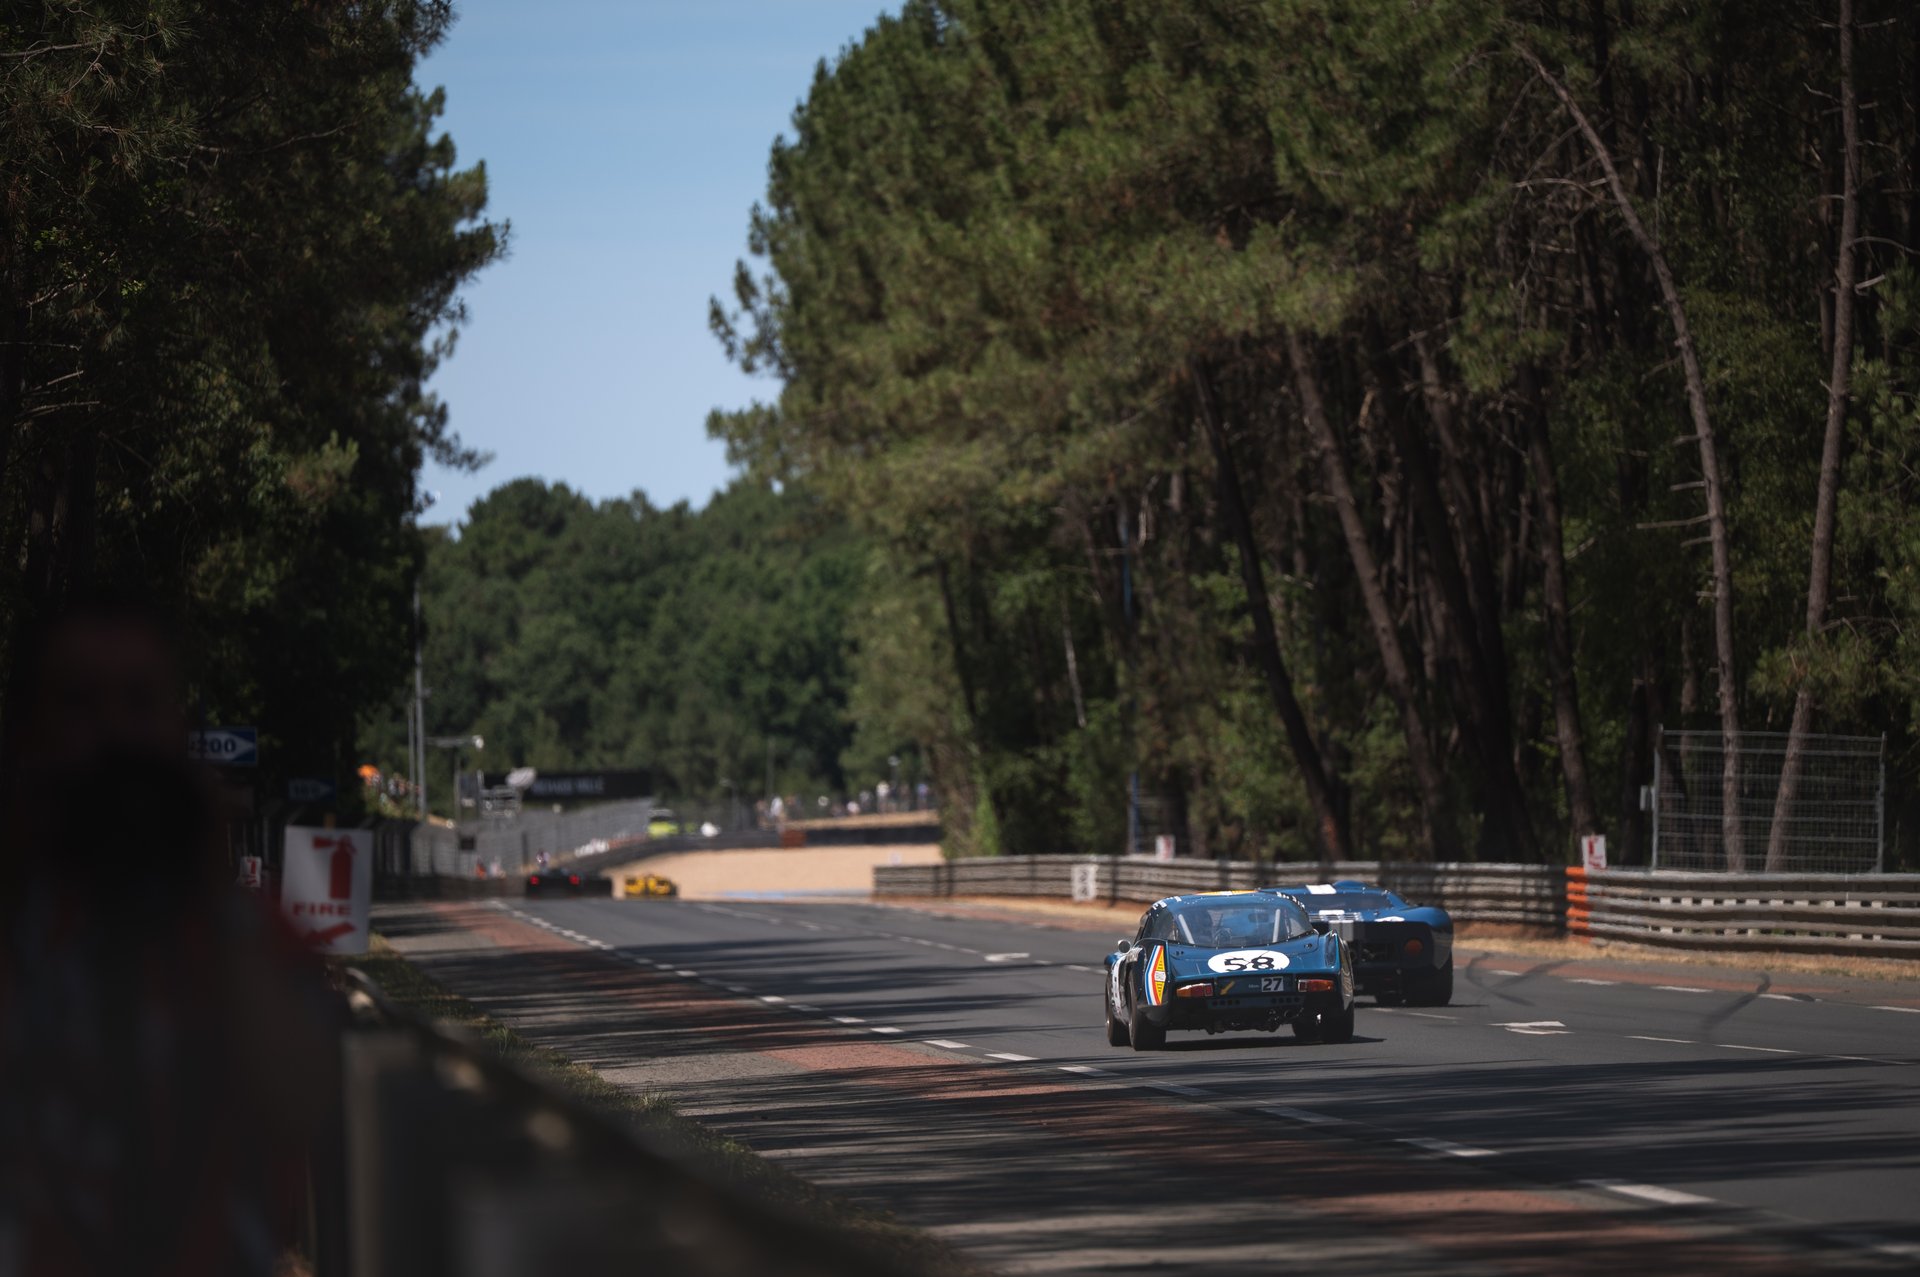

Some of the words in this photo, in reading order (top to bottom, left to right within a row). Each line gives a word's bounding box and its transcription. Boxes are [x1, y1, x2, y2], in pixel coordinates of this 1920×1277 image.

[292, 901, 352, 916] FIRE
[1224, 957, 1275, 972] 58
[1263, 978, 1283, 992] 27
